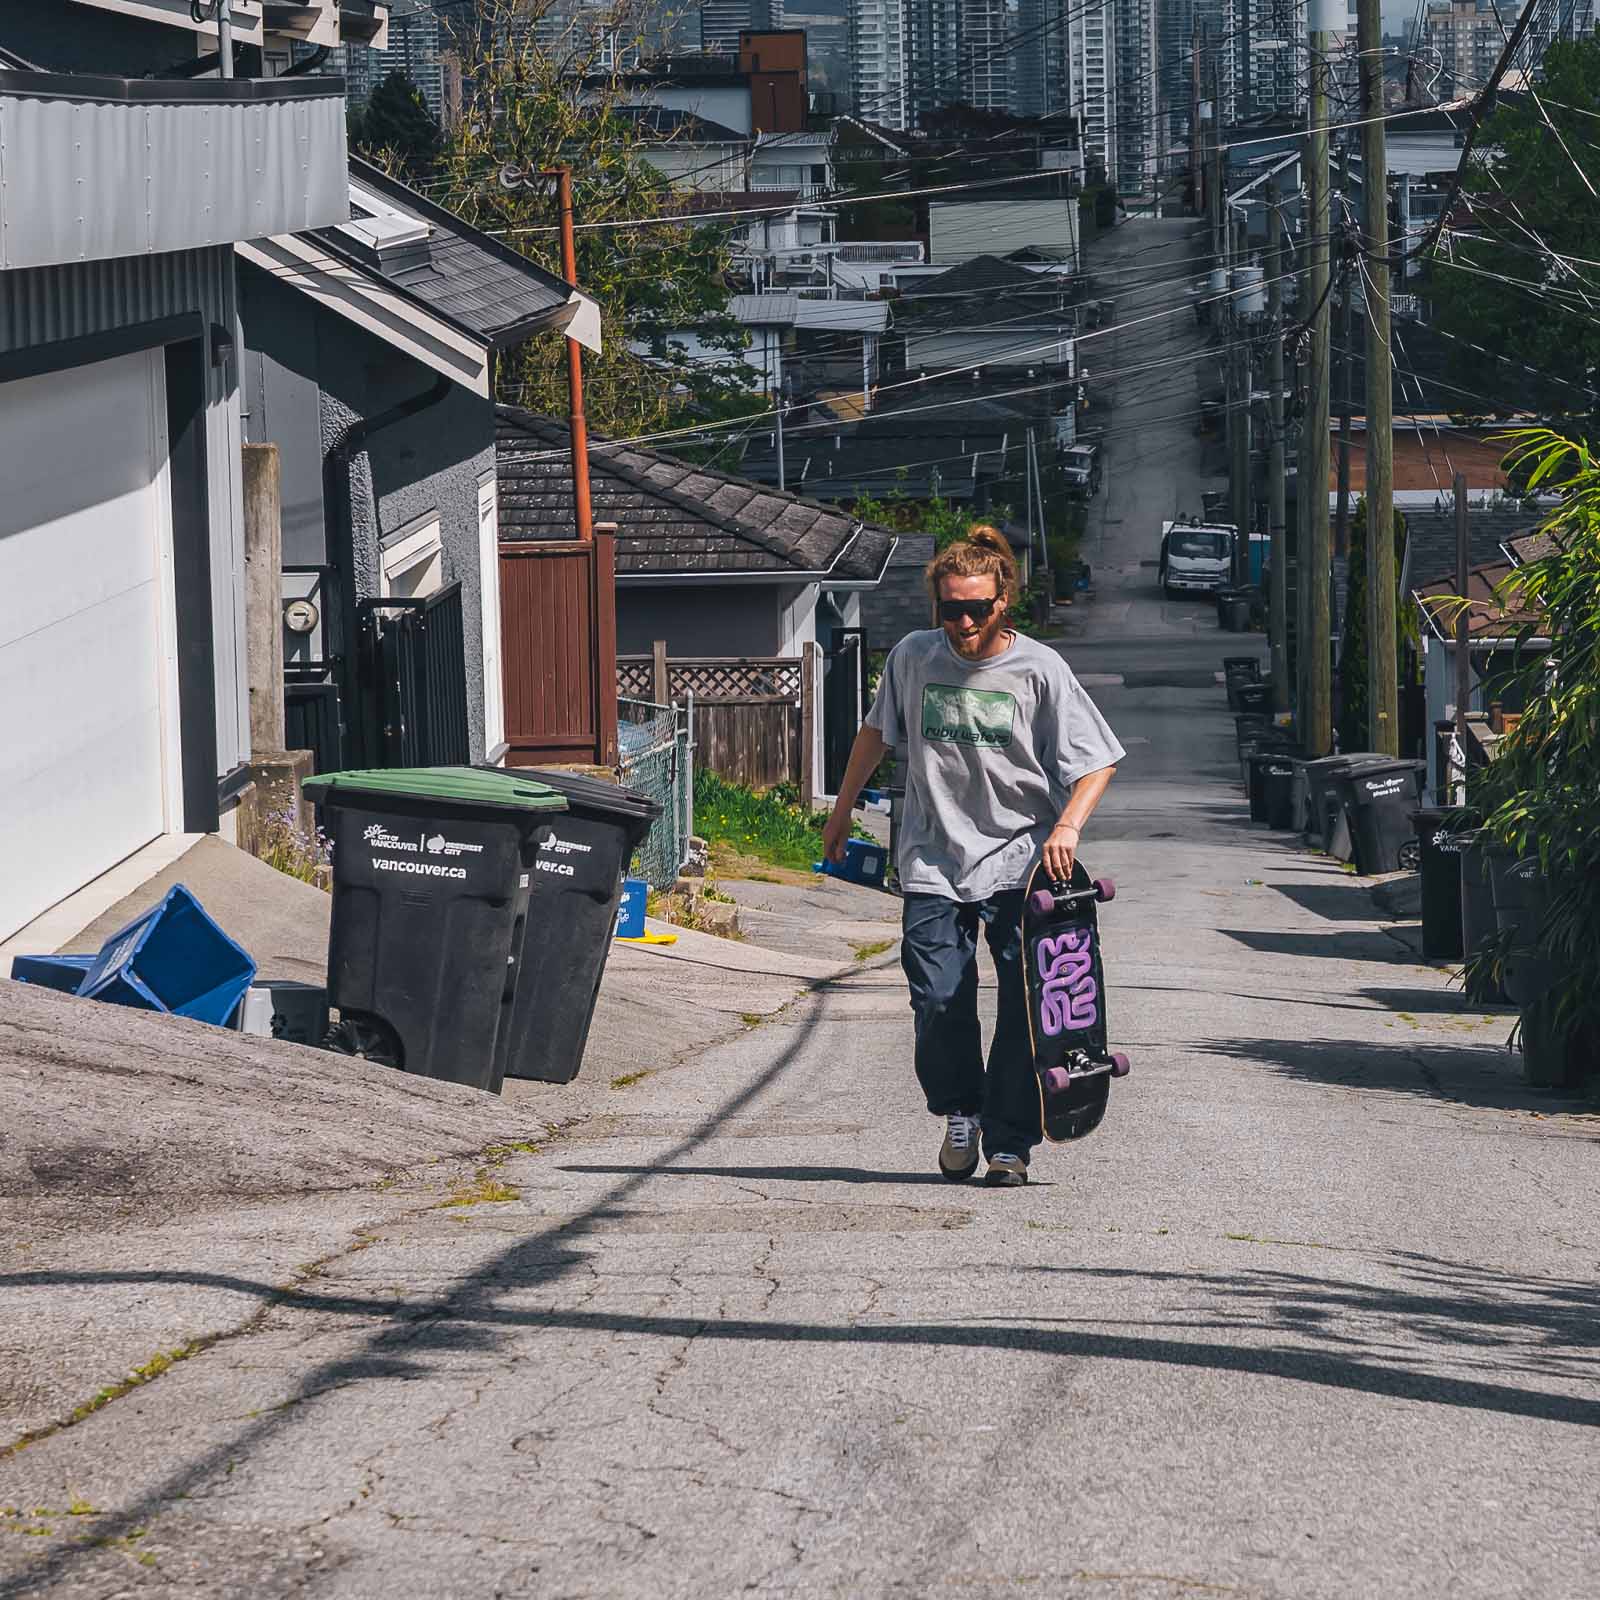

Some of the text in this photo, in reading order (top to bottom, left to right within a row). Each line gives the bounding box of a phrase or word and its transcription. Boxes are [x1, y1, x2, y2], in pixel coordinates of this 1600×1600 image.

[925, 727, 958, 740] ruby
[370, 839, 418, 852] VANCOUVER
[444, 848, 462, 856] CITY
[554, 846, 571, 854] CITY
[372, 858, 467, 879] vancouver.ca
